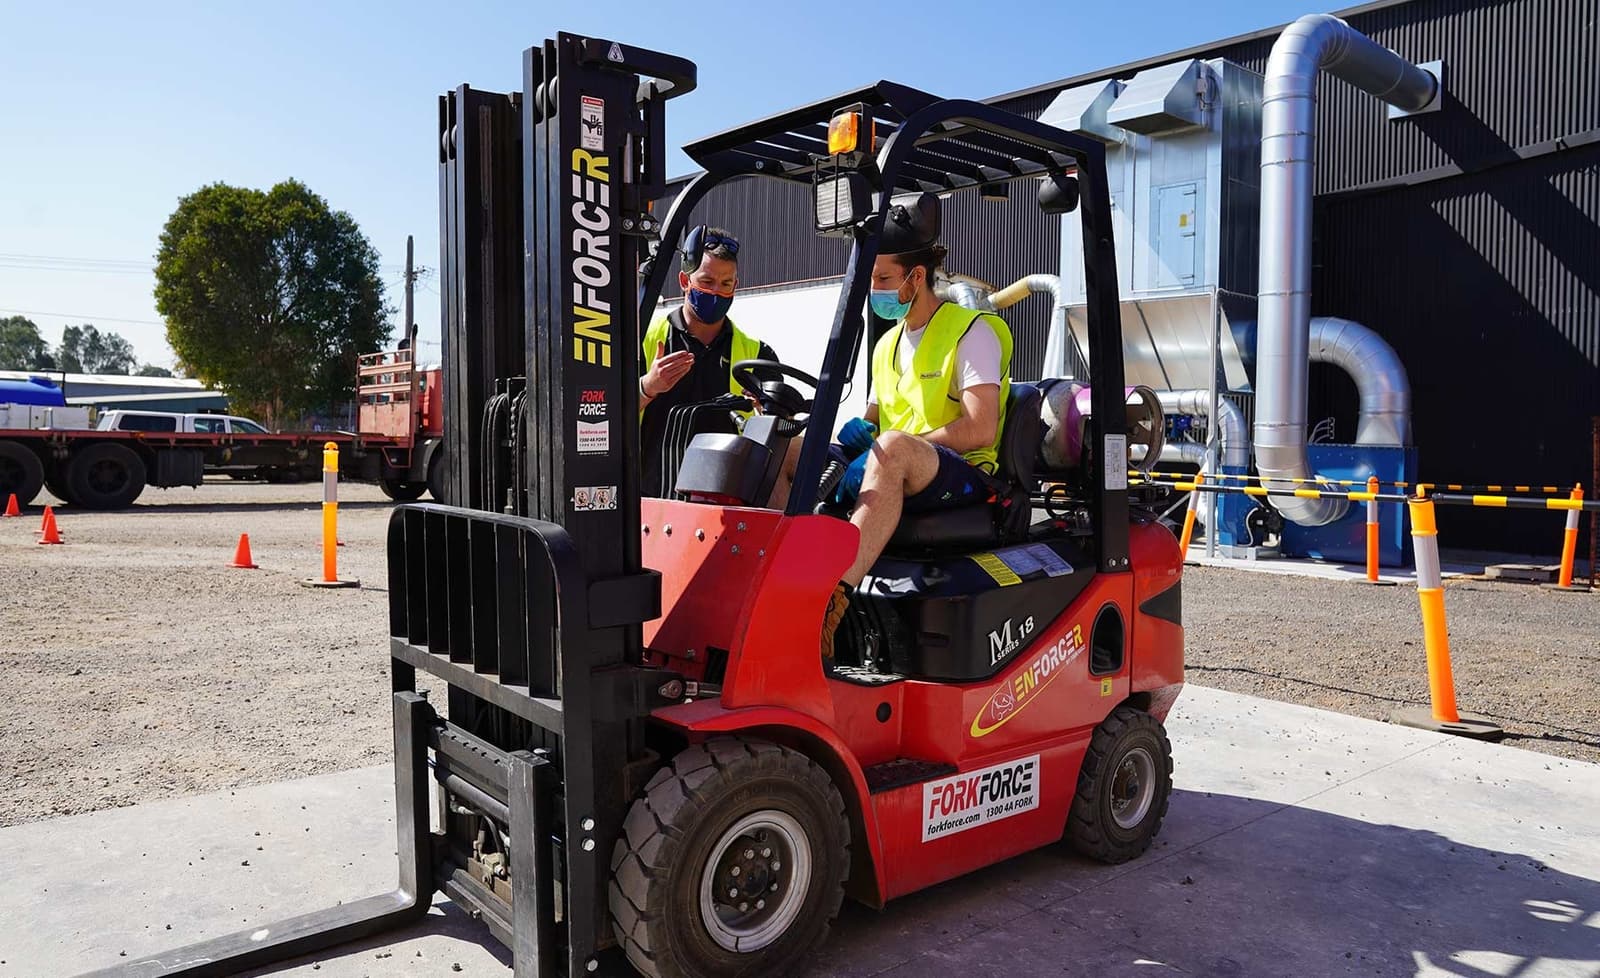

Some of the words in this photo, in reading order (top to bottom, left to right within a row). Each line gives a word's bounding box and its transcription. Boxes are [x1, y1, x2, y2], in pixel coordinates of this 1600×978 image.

[571, 148, 611, 368] ENFORCER
[578, 403, 608, 415] FORCE
[581, 390, 606, 402] FORK
[988, 618, 1012, 667] M
[1018, 616, 1034, 639] 18
[997, 639, 1019, 660] SERIES
[1014, 624, 1083, 701] ENFORCER
[929, 762, 1034, 820] FORKFORCE
[927, 813, 980, 835] forkforce.com
[986, 805, 1003, 818] 1300
[1004, 802, 1013, 813] 4A
[1014, 795, 1034, 810] FORK
